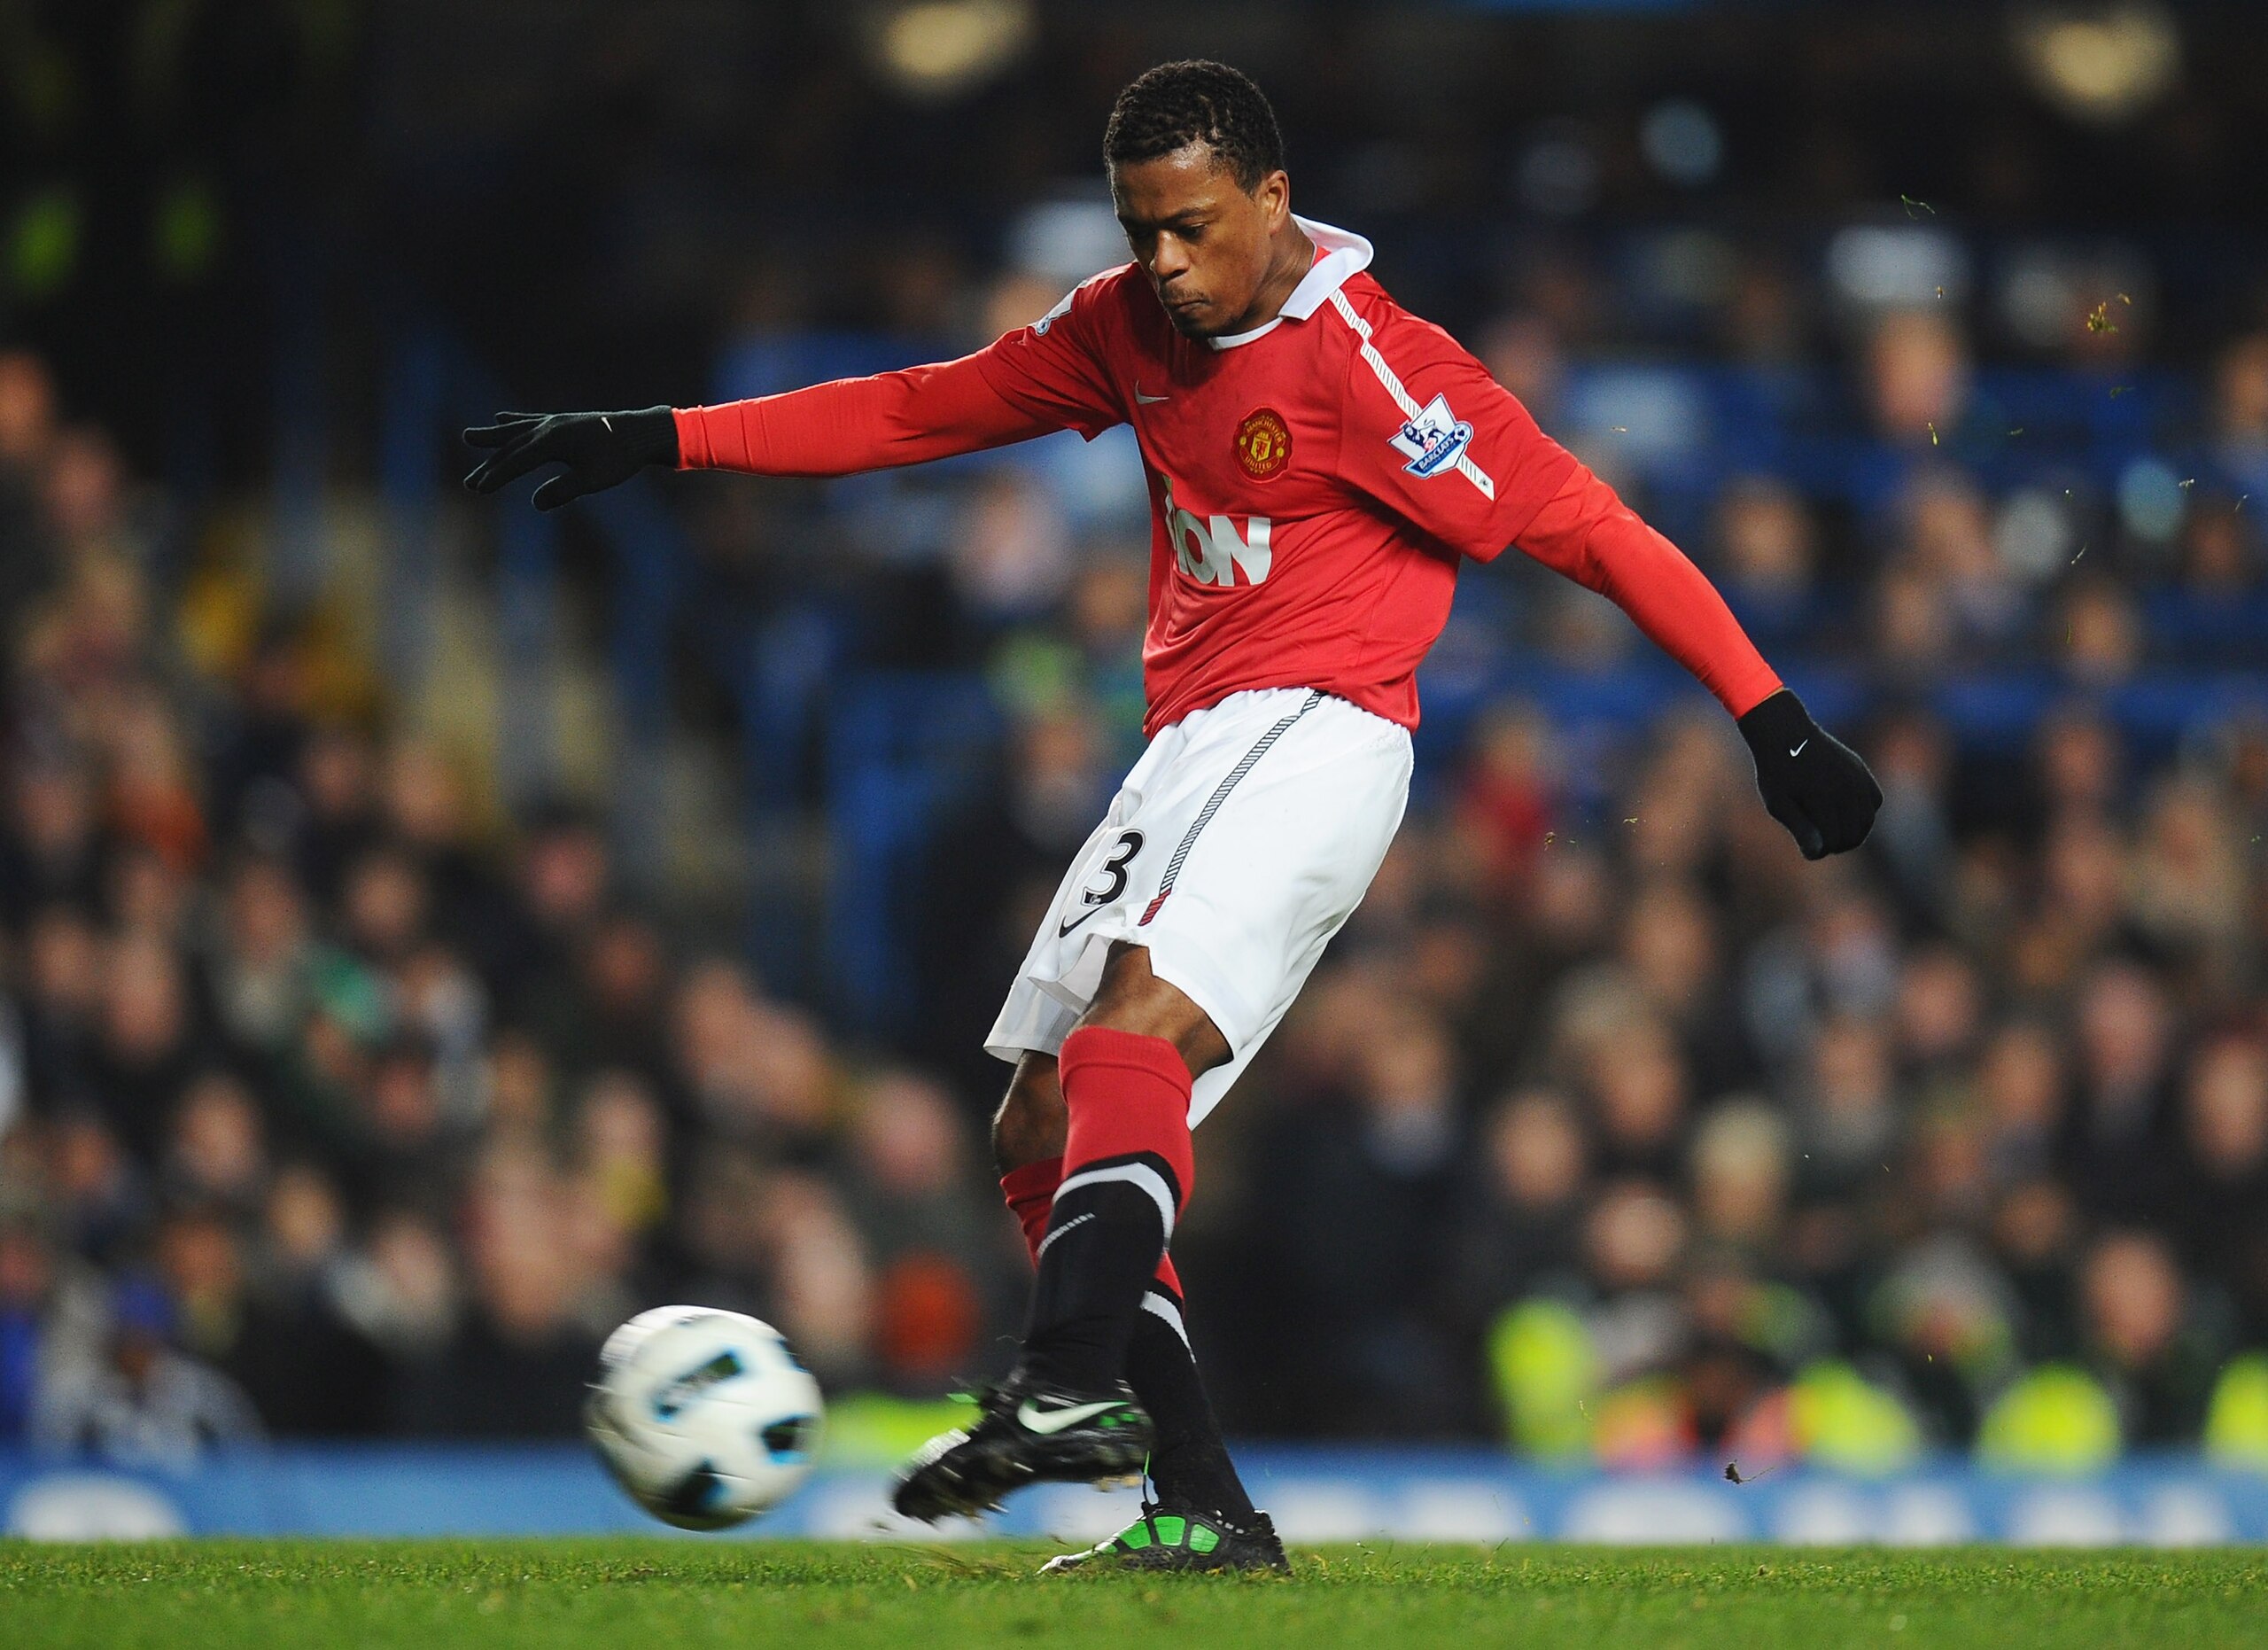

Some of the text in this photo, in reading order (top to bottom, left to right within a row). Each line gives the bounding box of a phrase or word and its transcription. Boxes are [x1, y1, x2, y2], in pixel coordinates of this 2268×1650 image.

[1246, 418, 1282, 442] MANCHESTER
[1245, 455, 1272, 470] UNITED
[1418, 436, 1455, 469] BARCLAYS
[1082, 829, 1145, 906] 3
